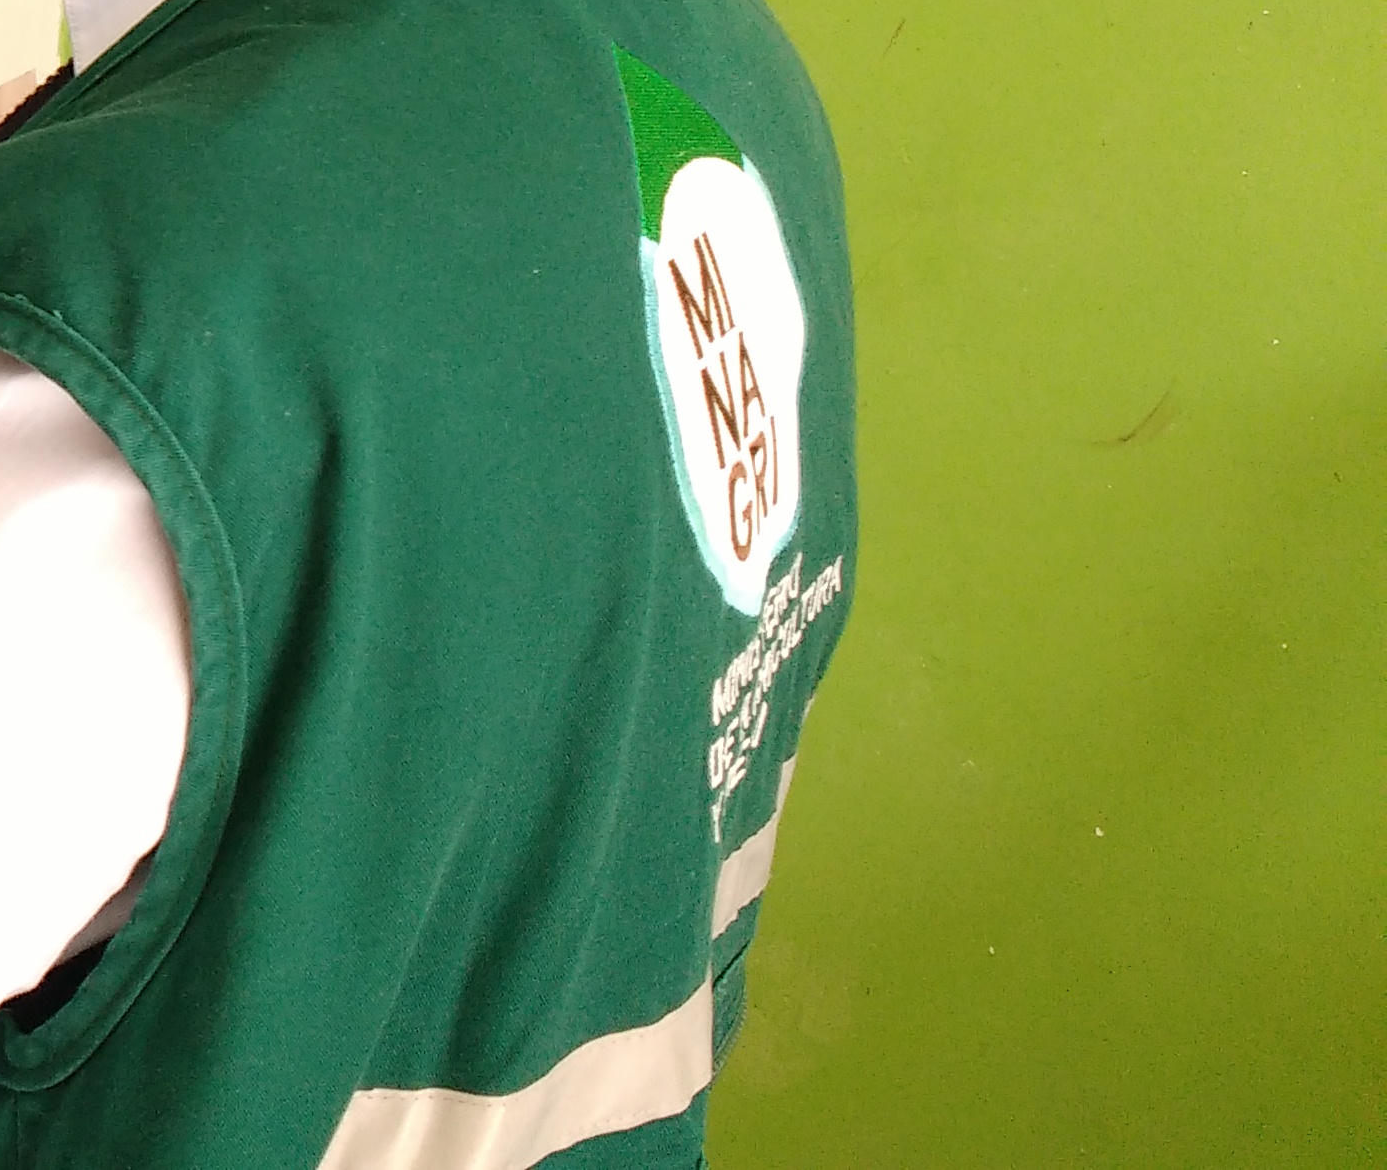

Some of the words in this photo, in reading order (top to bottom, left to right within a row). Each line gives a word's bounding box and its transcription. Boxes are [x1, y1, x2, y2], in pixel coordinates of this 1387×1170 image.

[668, 231, 736, 360] MI
[700, 330, 766, 470] NA
[728, 415, 778, 563] GRI
